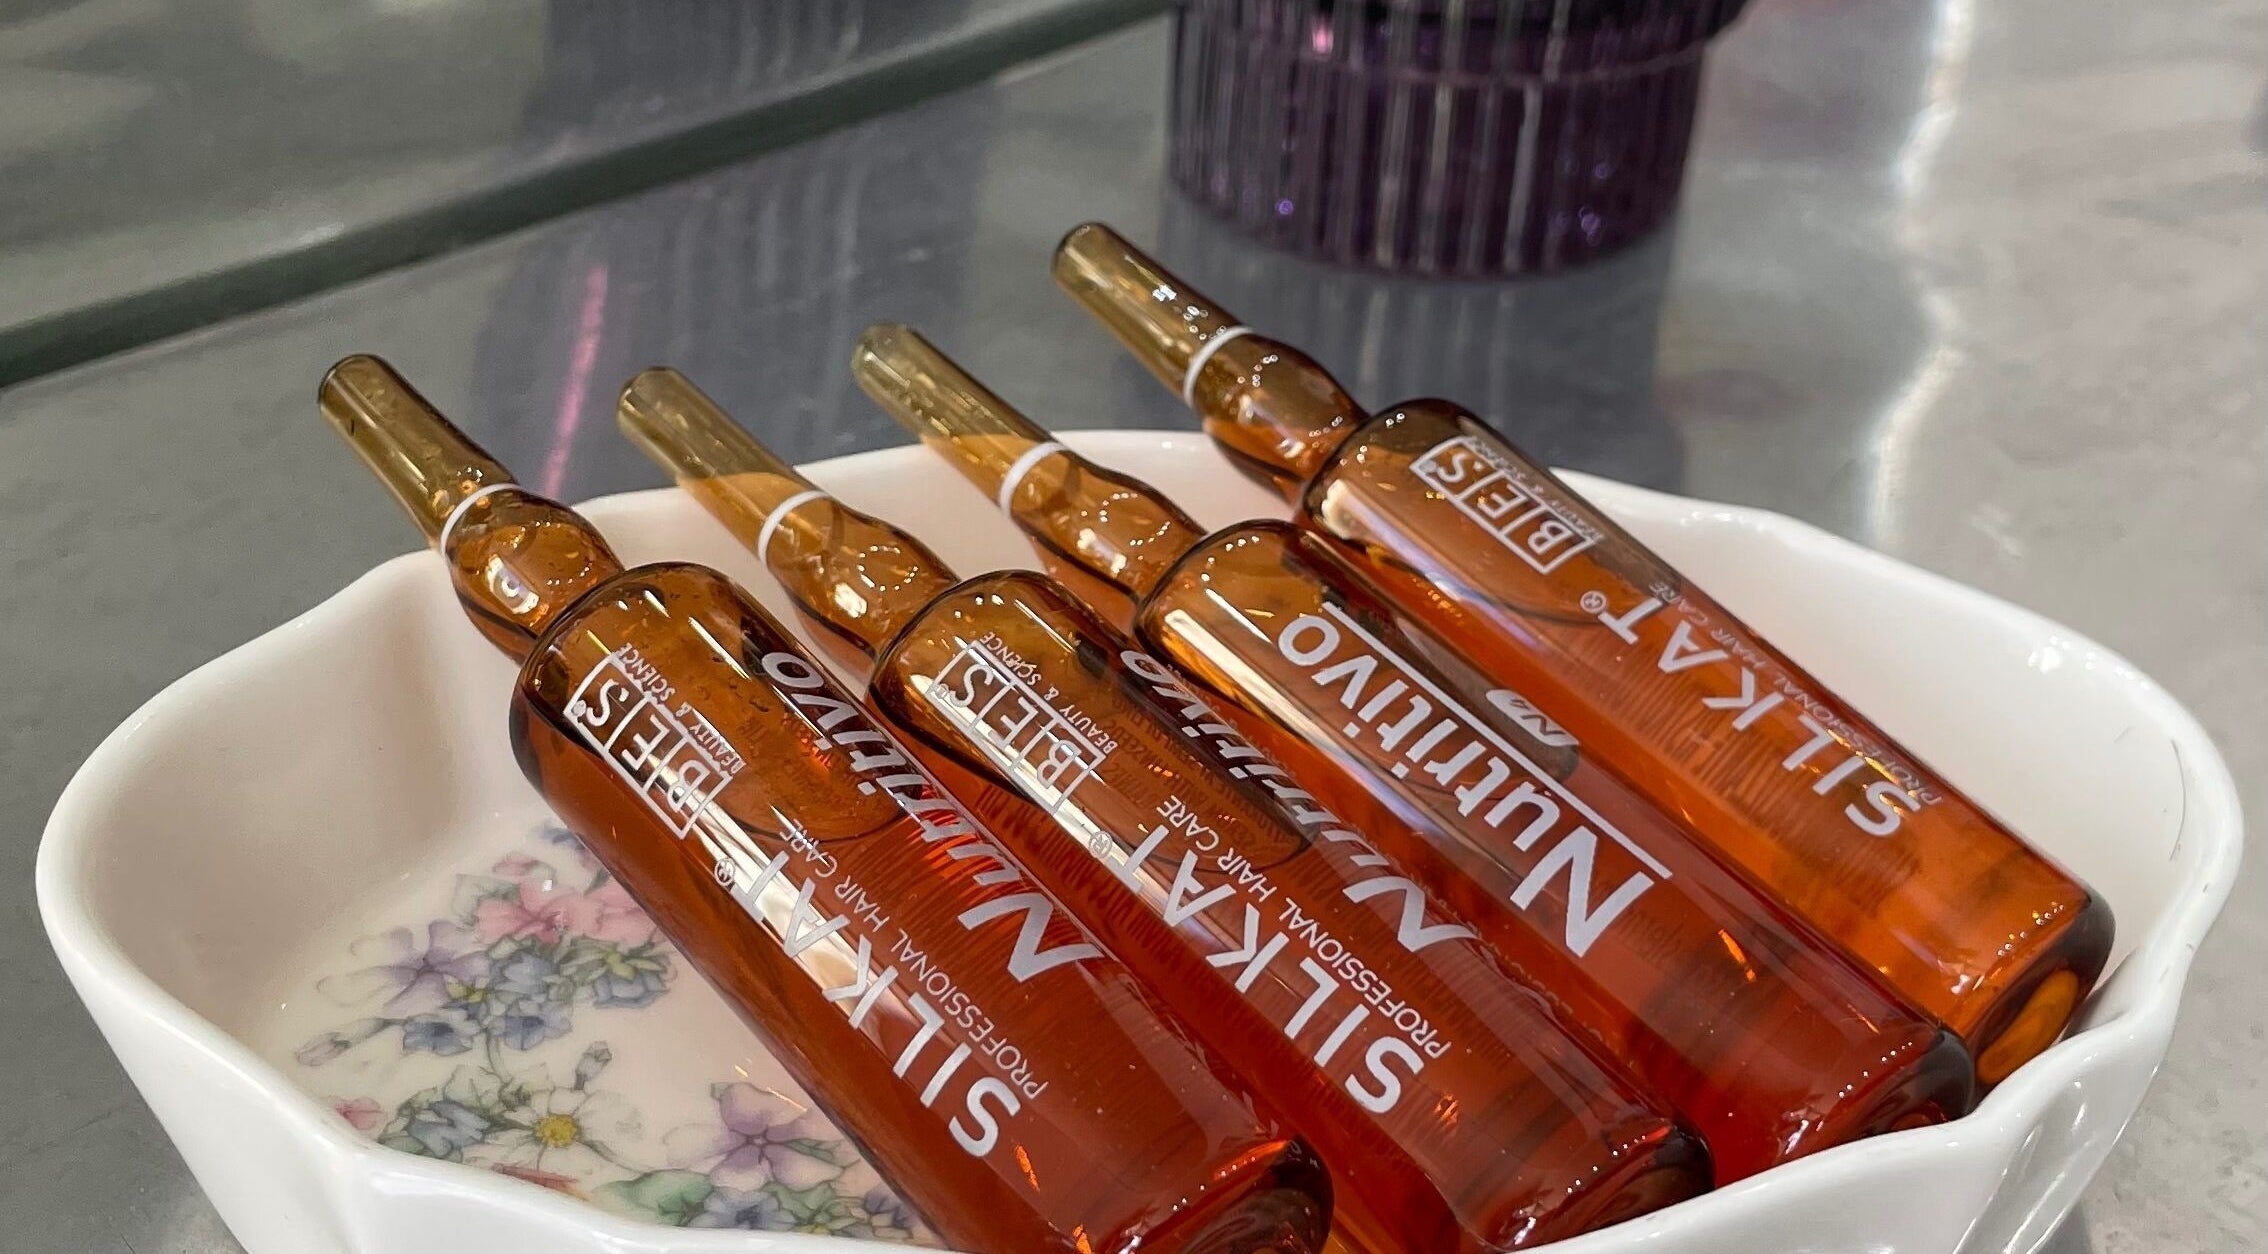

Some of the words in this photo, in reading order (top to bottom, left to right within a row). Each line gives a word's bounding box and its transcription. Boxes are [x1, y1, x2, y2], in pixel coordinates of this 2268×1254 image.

[1649, 582, 1709, 627] CARE
[617, 641, 677, 704] SCIENCE
[981, 632, 1043, 686] SCIENCE
[1712, 629, 1768, 669] HAIR
[686, 720, 745, 776] BEAUTY
[1060, 703, 1118, 755] BEAUTY
[1119, 649, 1476, 953] Nutritivo
[1277, 614, 1655, 958] Nutritivo
[759, 650, 1105, 984] Nutritivo
[1157, 795, 1221, 851] CARE
[779, 817, 838, 878] CARE
[1216, 846, 1277, 903] HAIR
[834, 876, 891, 932] HAIR
[1274, 898, 1451, 1061] PROFESSIONAL
[891, 929, 1049, 1100] PROFESSIONAL
